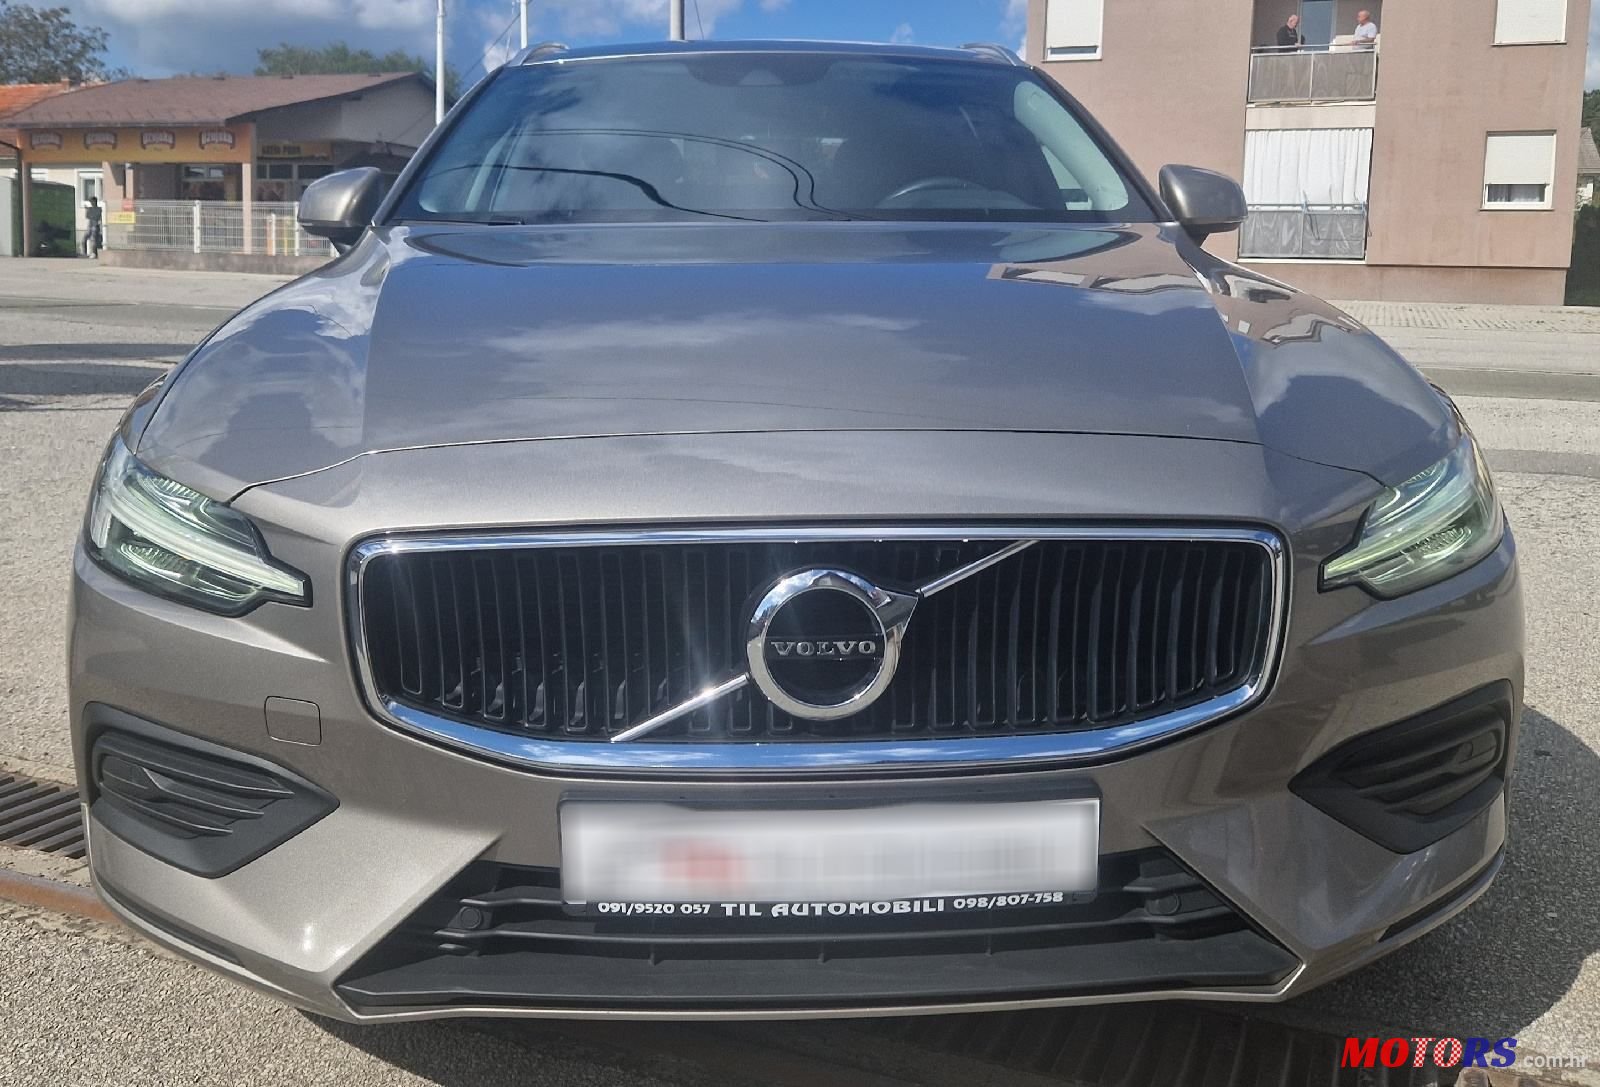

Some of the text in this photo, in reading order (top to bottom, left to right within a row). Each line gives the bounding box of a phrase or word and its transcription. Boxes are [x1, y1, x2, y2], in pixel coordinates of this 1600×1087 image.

[770, 640, 877, 657] VOLVO
[597, 891, 1065, 918] 091/9520 057 TIL AUTOMOBILI 098/807-758
